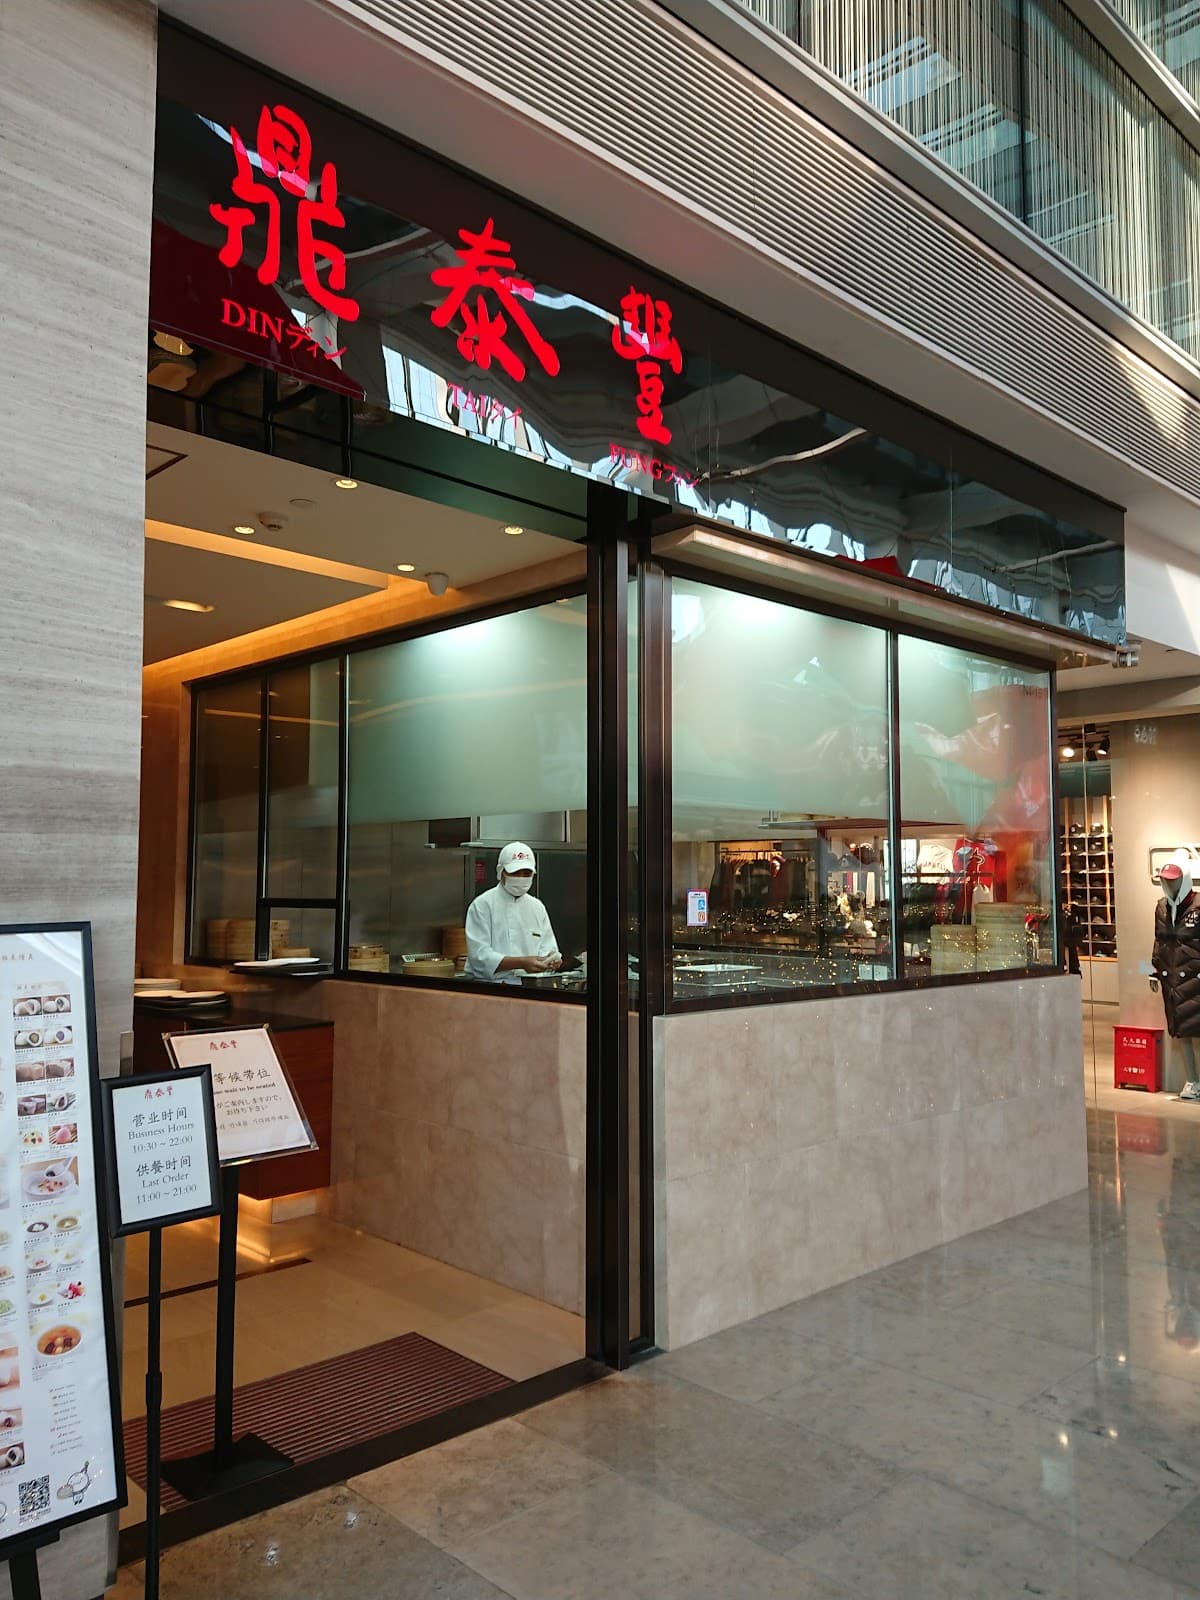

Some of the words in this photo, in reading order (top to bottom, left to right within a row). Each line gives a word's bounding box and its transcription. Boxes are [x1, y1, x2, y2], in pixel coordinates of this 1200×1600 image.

[132, 1106, 188, 1128] 营业时间
[128, 1127, 165, 1140] Business
[168, 1122, 195, 1133] Hours
[132, 1141, 157, 1153] 10:30
[169, 1135, 193, 1147] 22:00
[136, 1155, 191, 1177] 供餐时间
[142, 1179, 159, 1189] Last
[162, 1172, 189, 1184] Order
[137, 1192, 161, 1204] 11:00
[173, 1184, 197, 1197] 21:00
